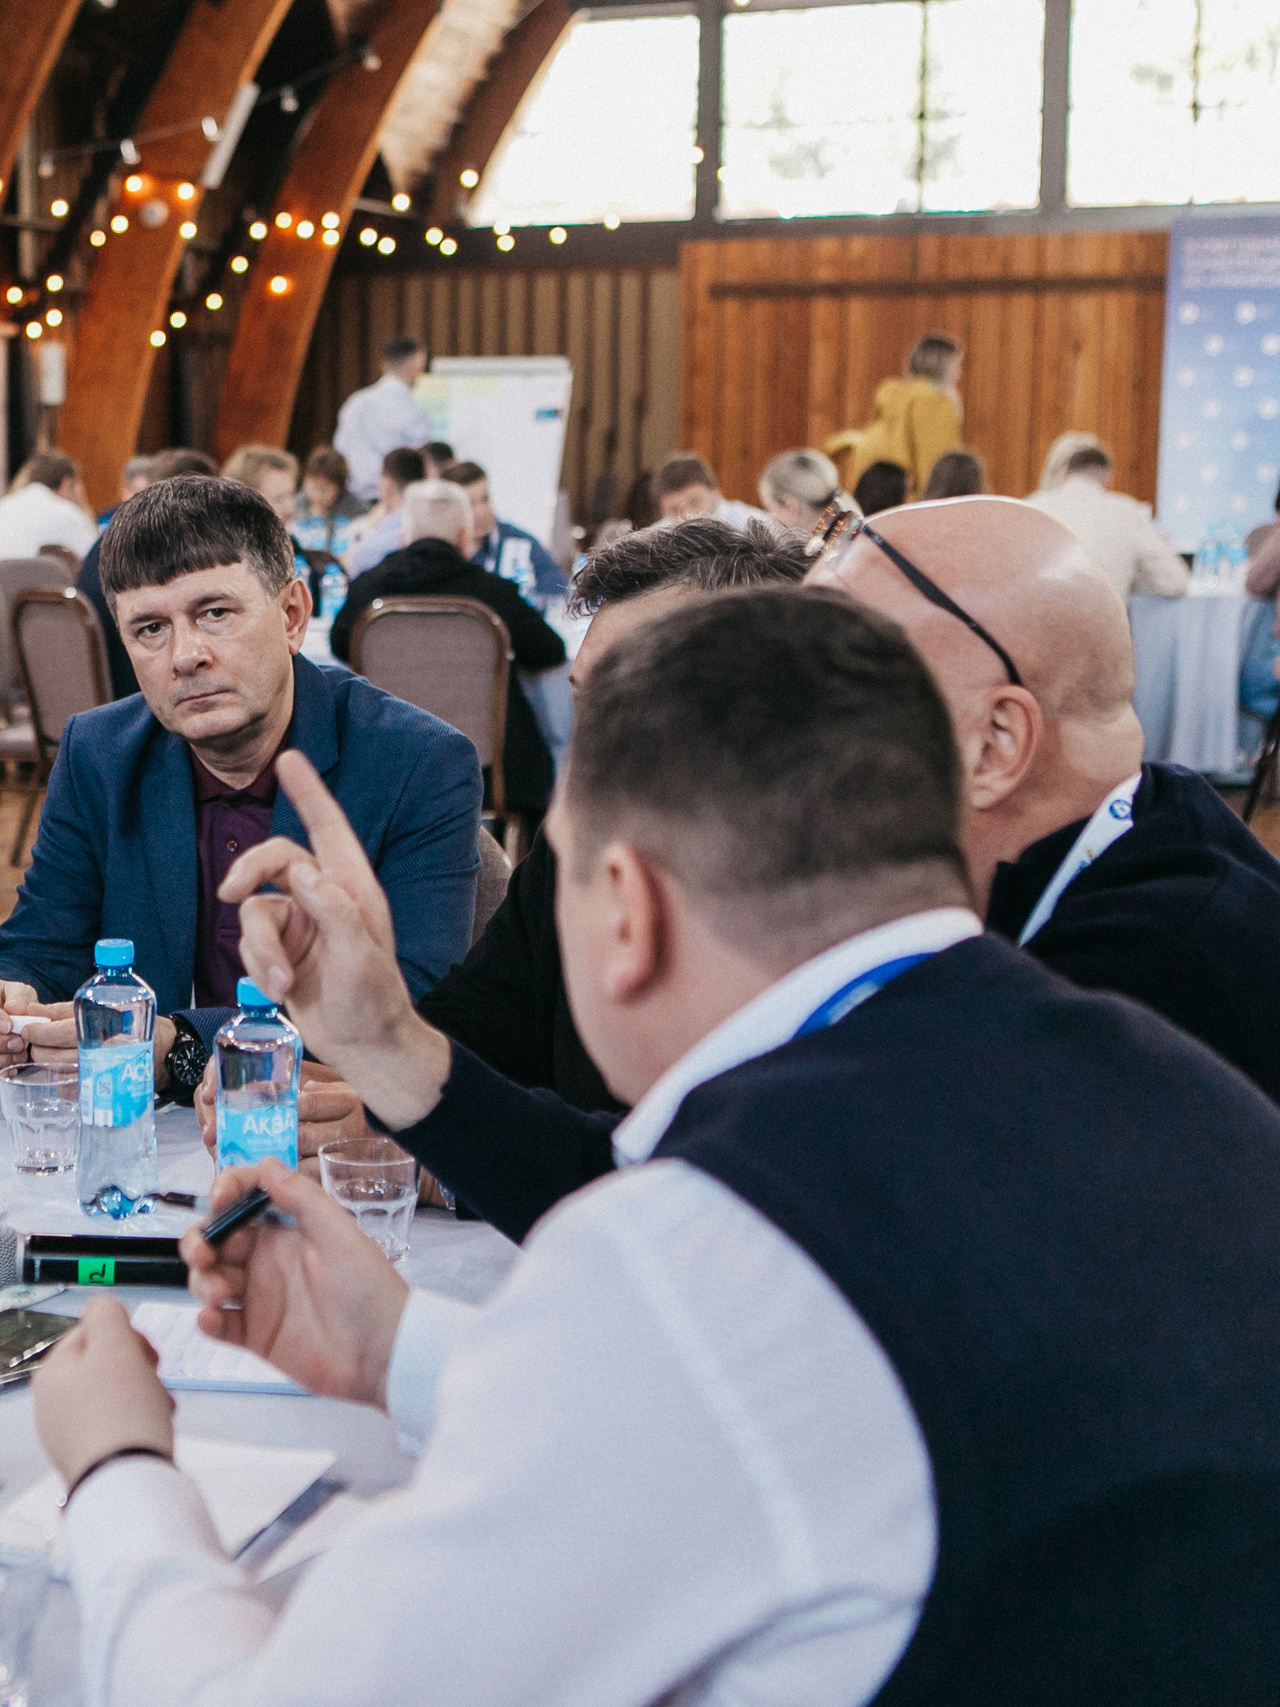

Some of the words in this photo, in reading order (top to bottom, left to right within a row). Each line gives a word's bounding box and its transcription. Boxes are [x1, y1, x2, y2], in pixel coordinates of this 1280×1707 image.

[121, 1061, 153, 1083] AQU
[242, 1107, 295, 1136] АКВА
[88, 1263, 106, 1284] 12
